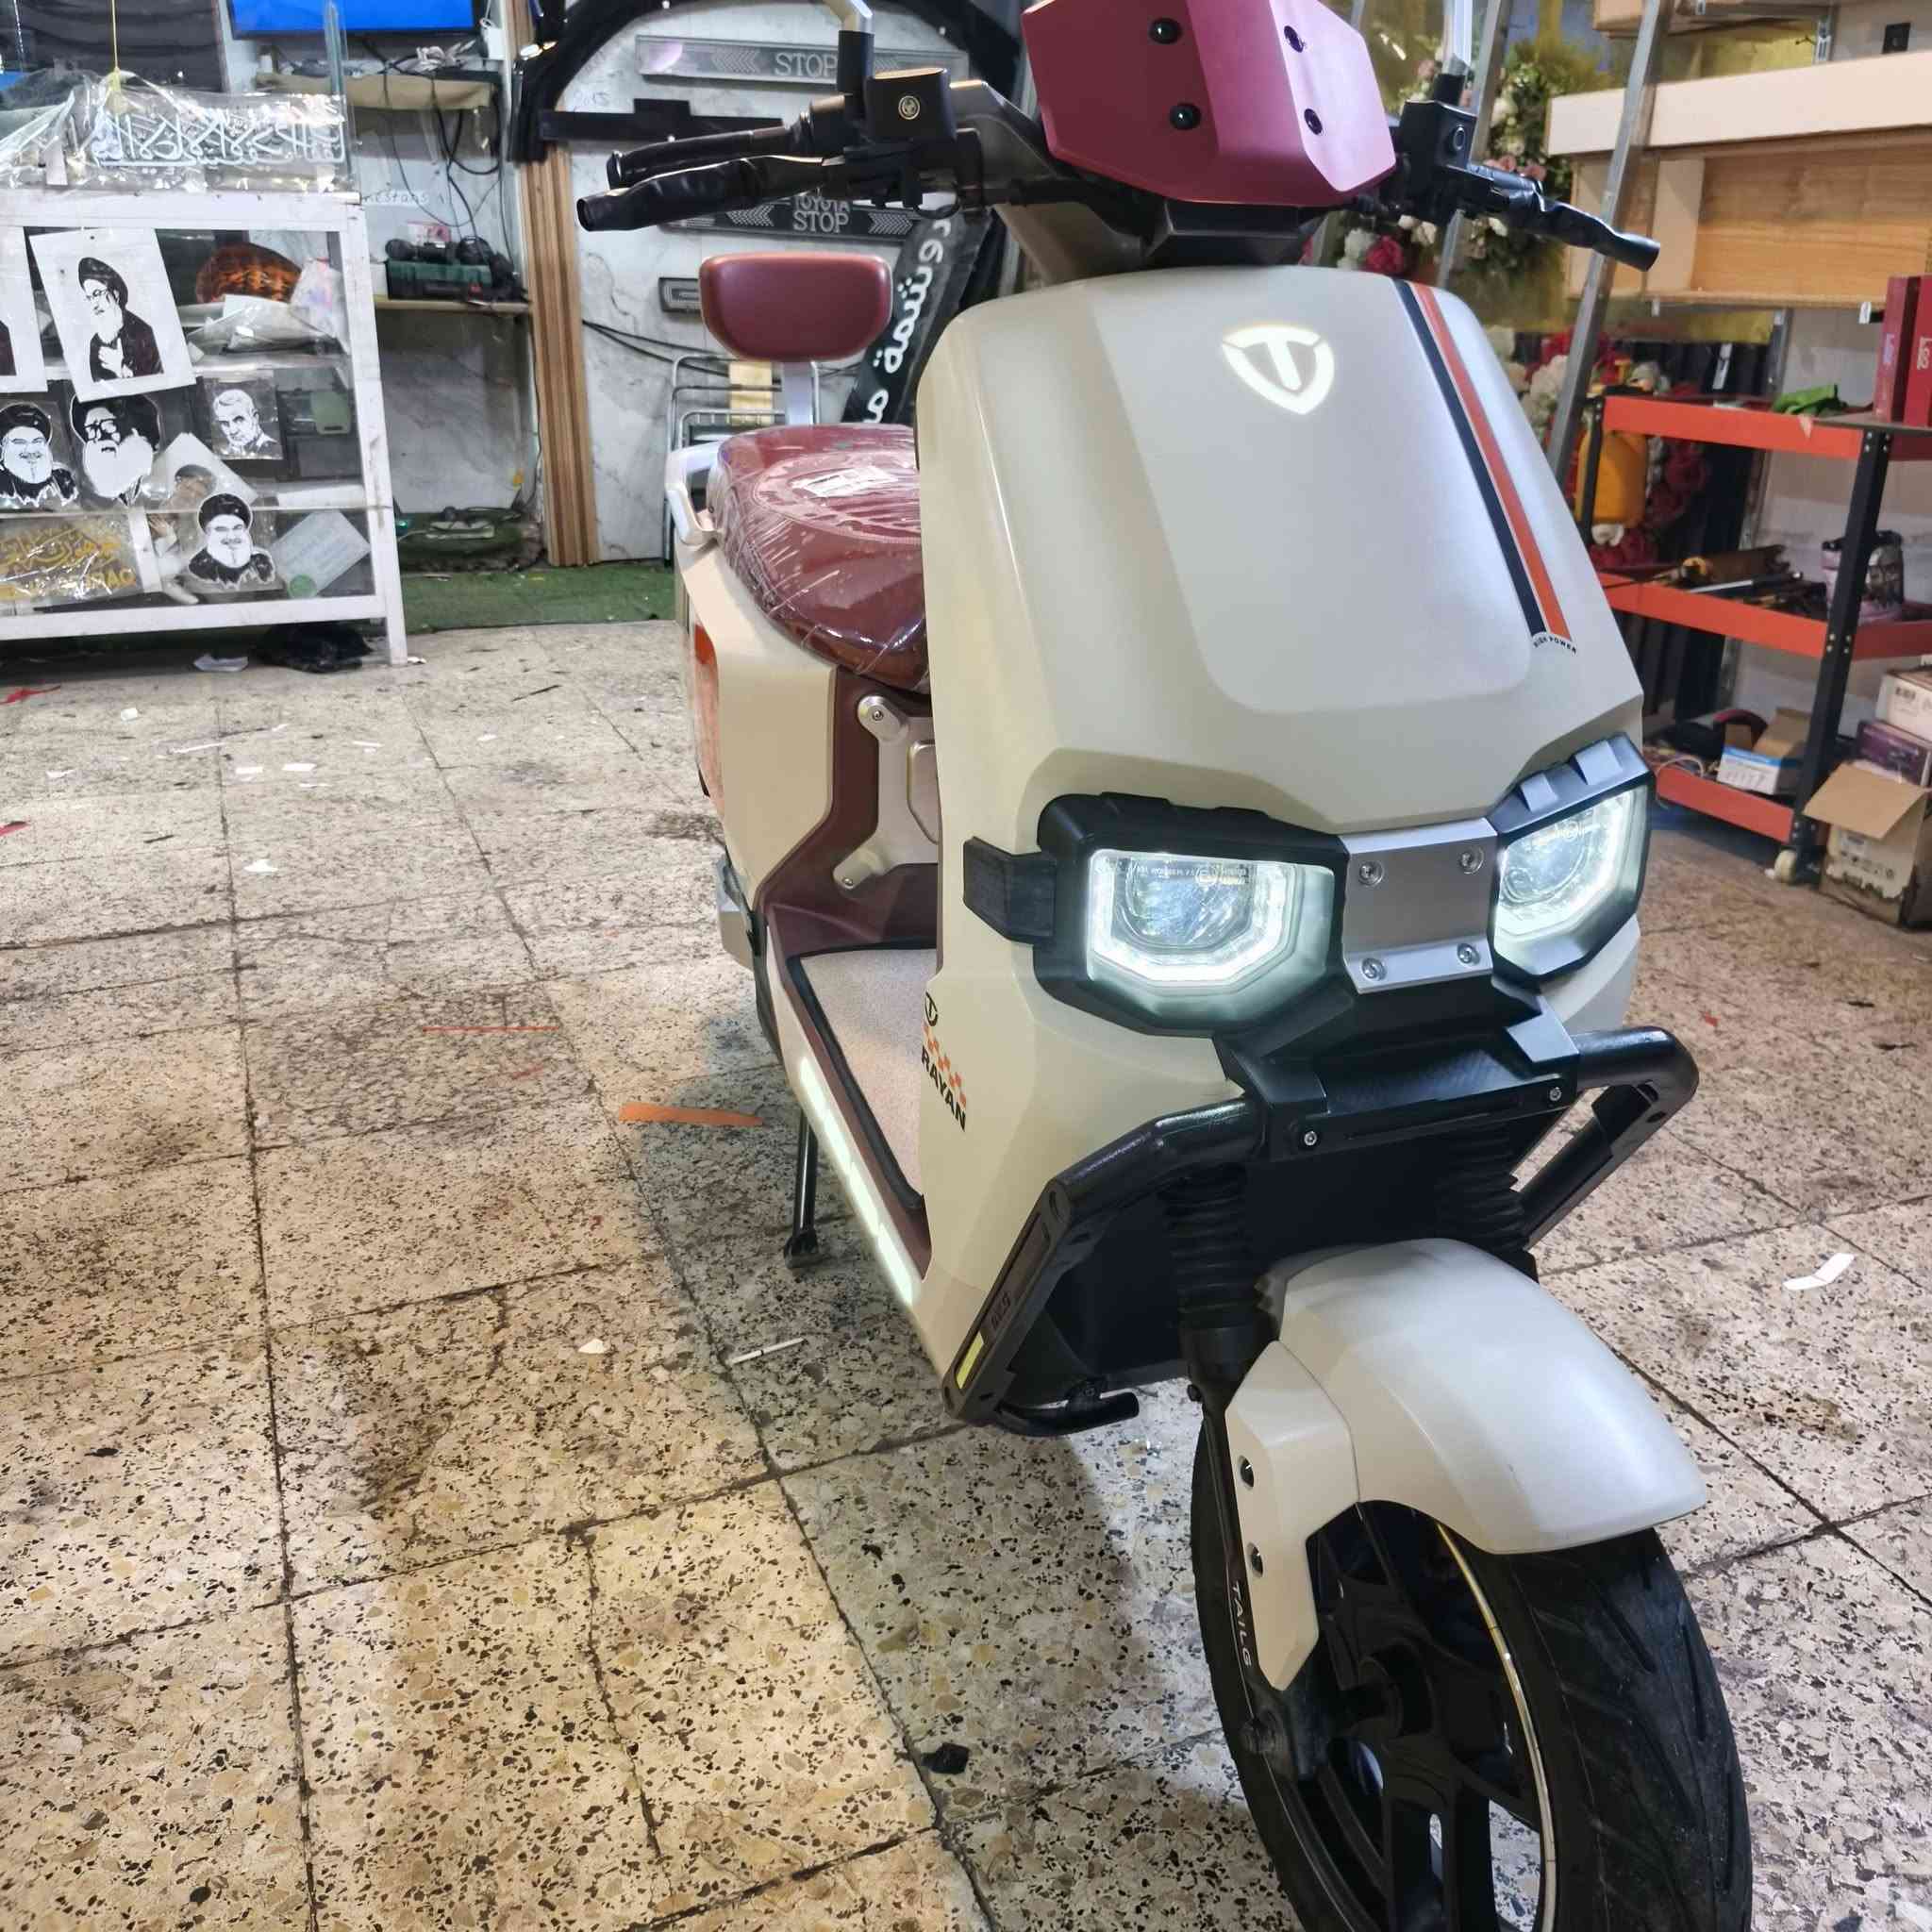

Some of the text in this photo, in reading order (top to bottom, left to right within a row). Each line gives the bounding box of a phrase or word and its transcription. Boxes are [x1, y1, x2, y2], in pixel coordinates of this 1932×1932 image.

[774, 52, 838, 76] STOP
[794, 196, 850, 212] TOYOTA
[793, 210, 849, 233] STOP
[1548, 636, 1576, 655] POWER
[921, 1044, 966, 1132] RAYAN
[1232, 1580, 1252, 1667] TAILG
